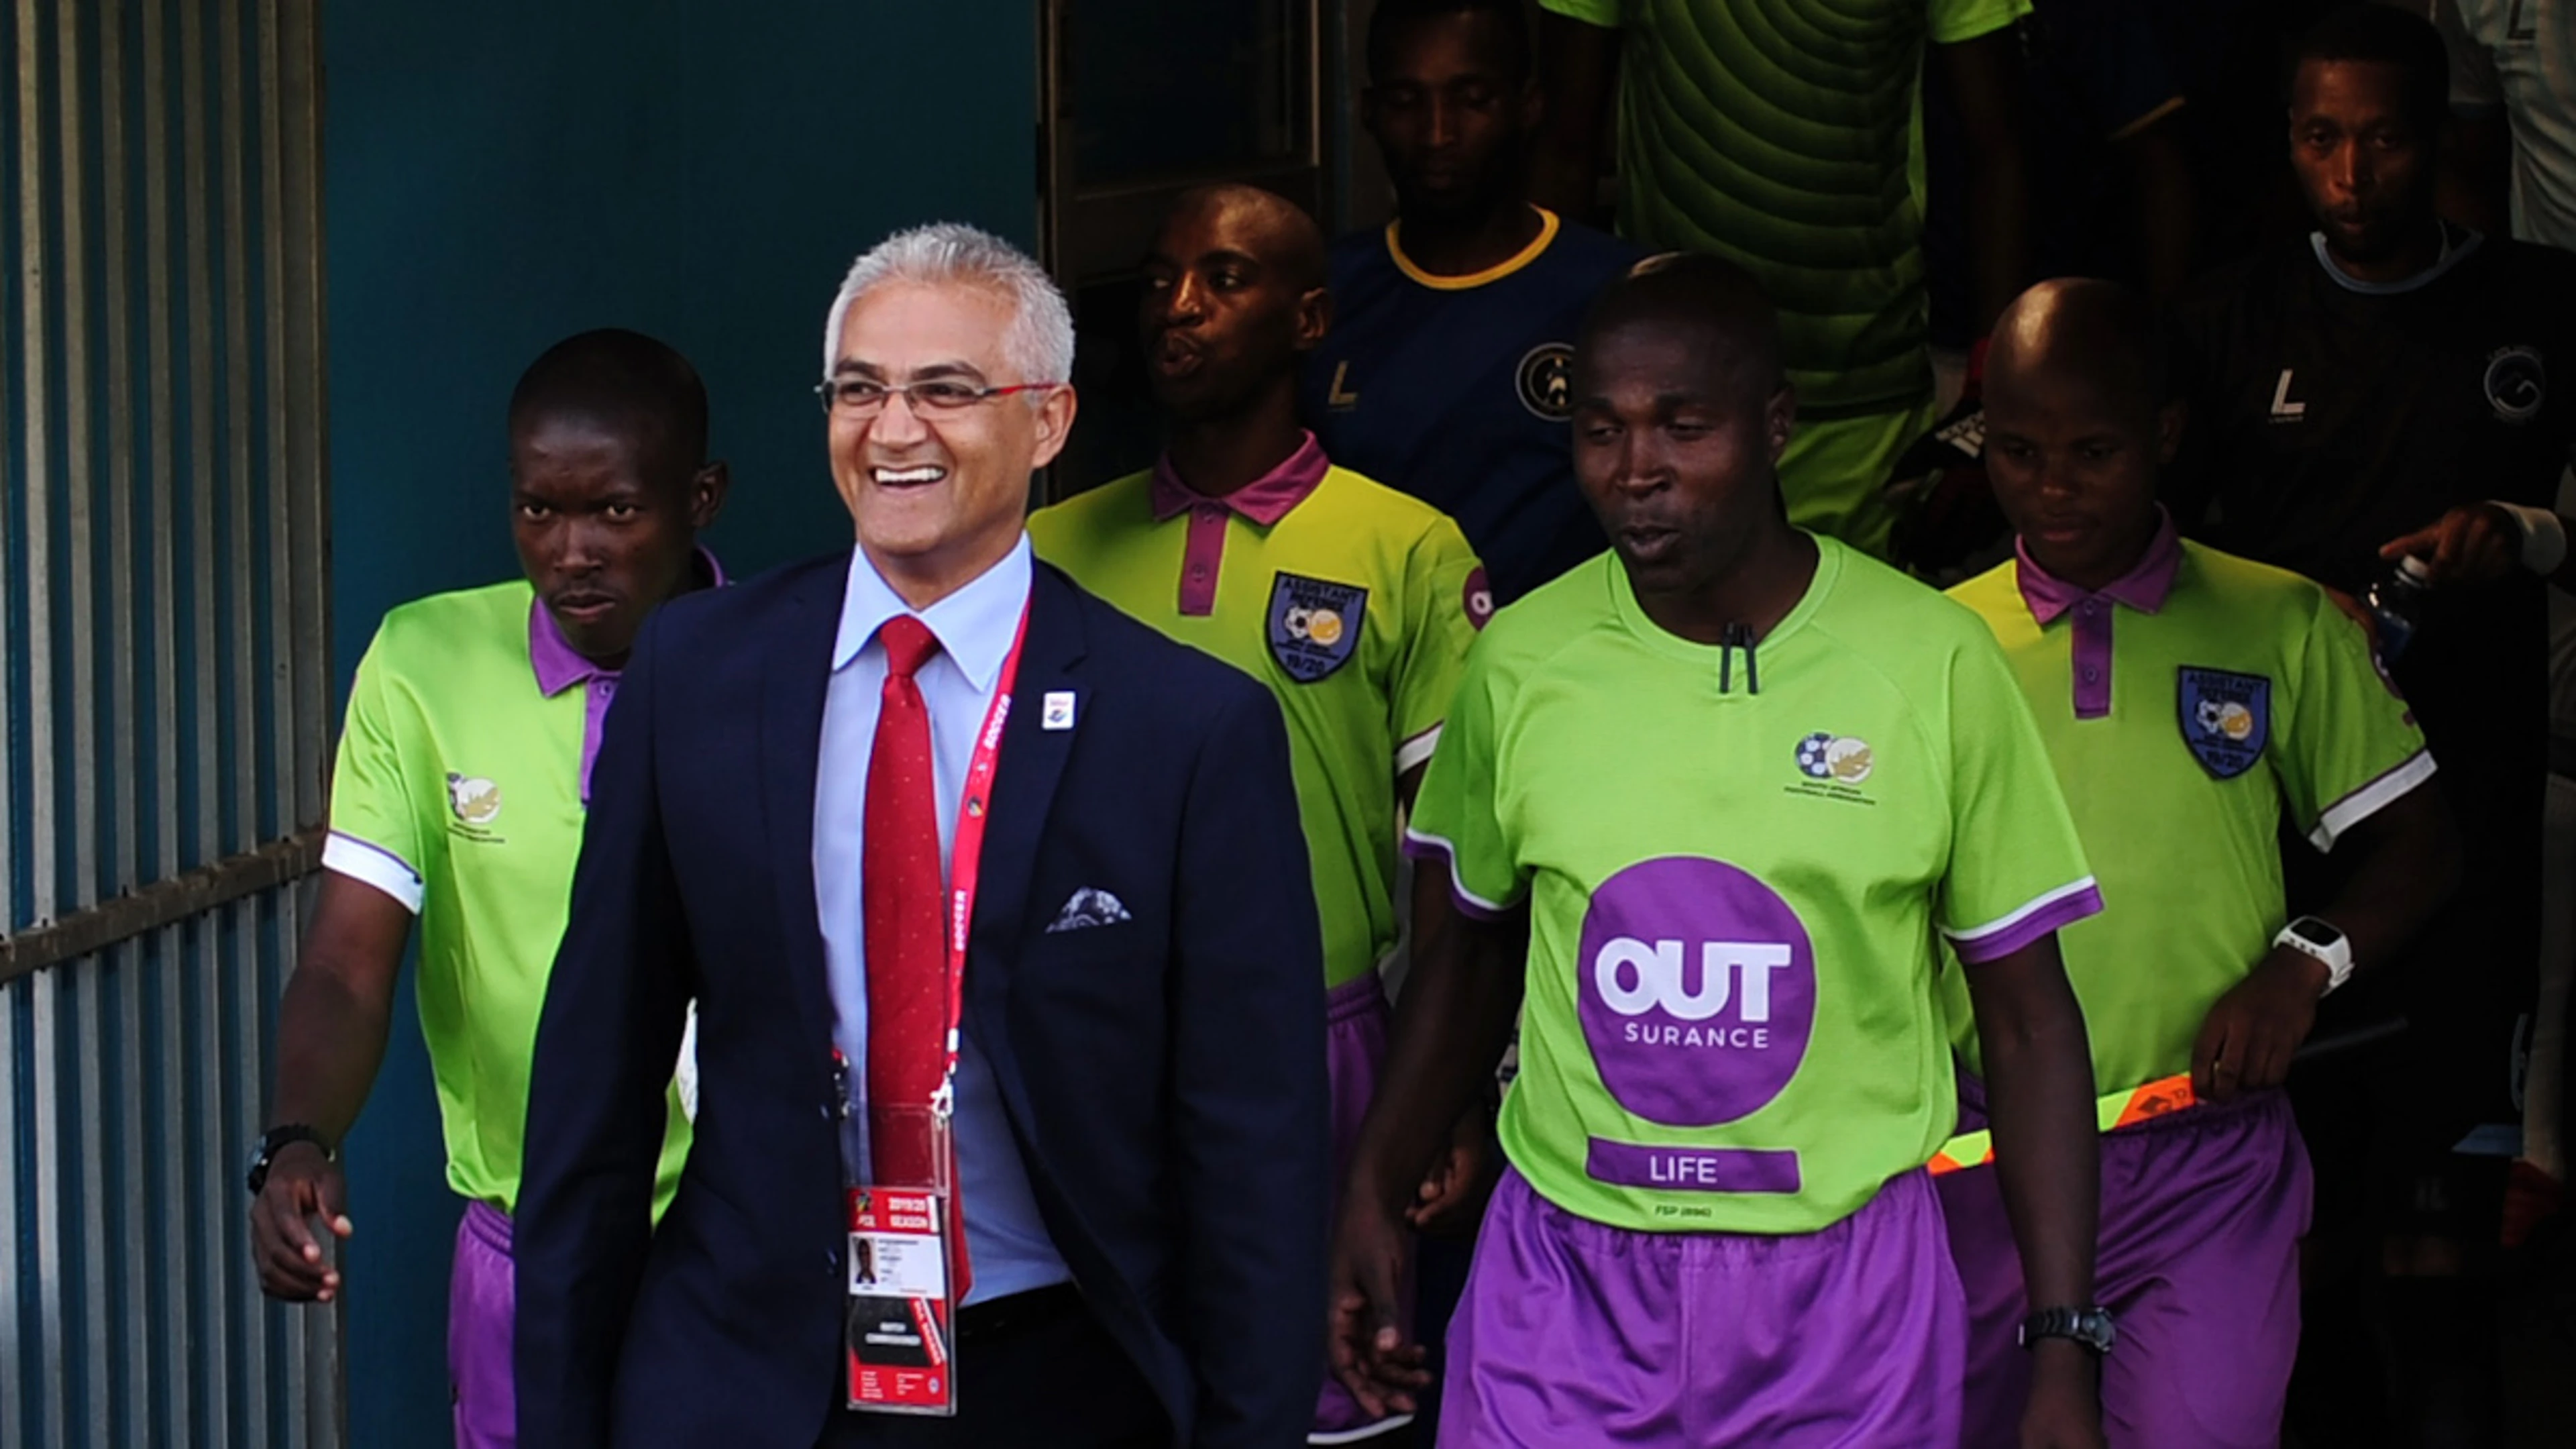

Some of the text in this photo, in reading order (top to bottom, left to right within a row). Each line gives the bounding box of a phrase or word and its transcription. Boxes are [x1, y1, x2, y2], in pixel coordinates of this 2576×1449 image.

[1594, 937, 1792, 1022] OUT
[1624, 1022, 1770, 1049] SURANCE
[1650, 1155, 1718, 1184] LIFE
